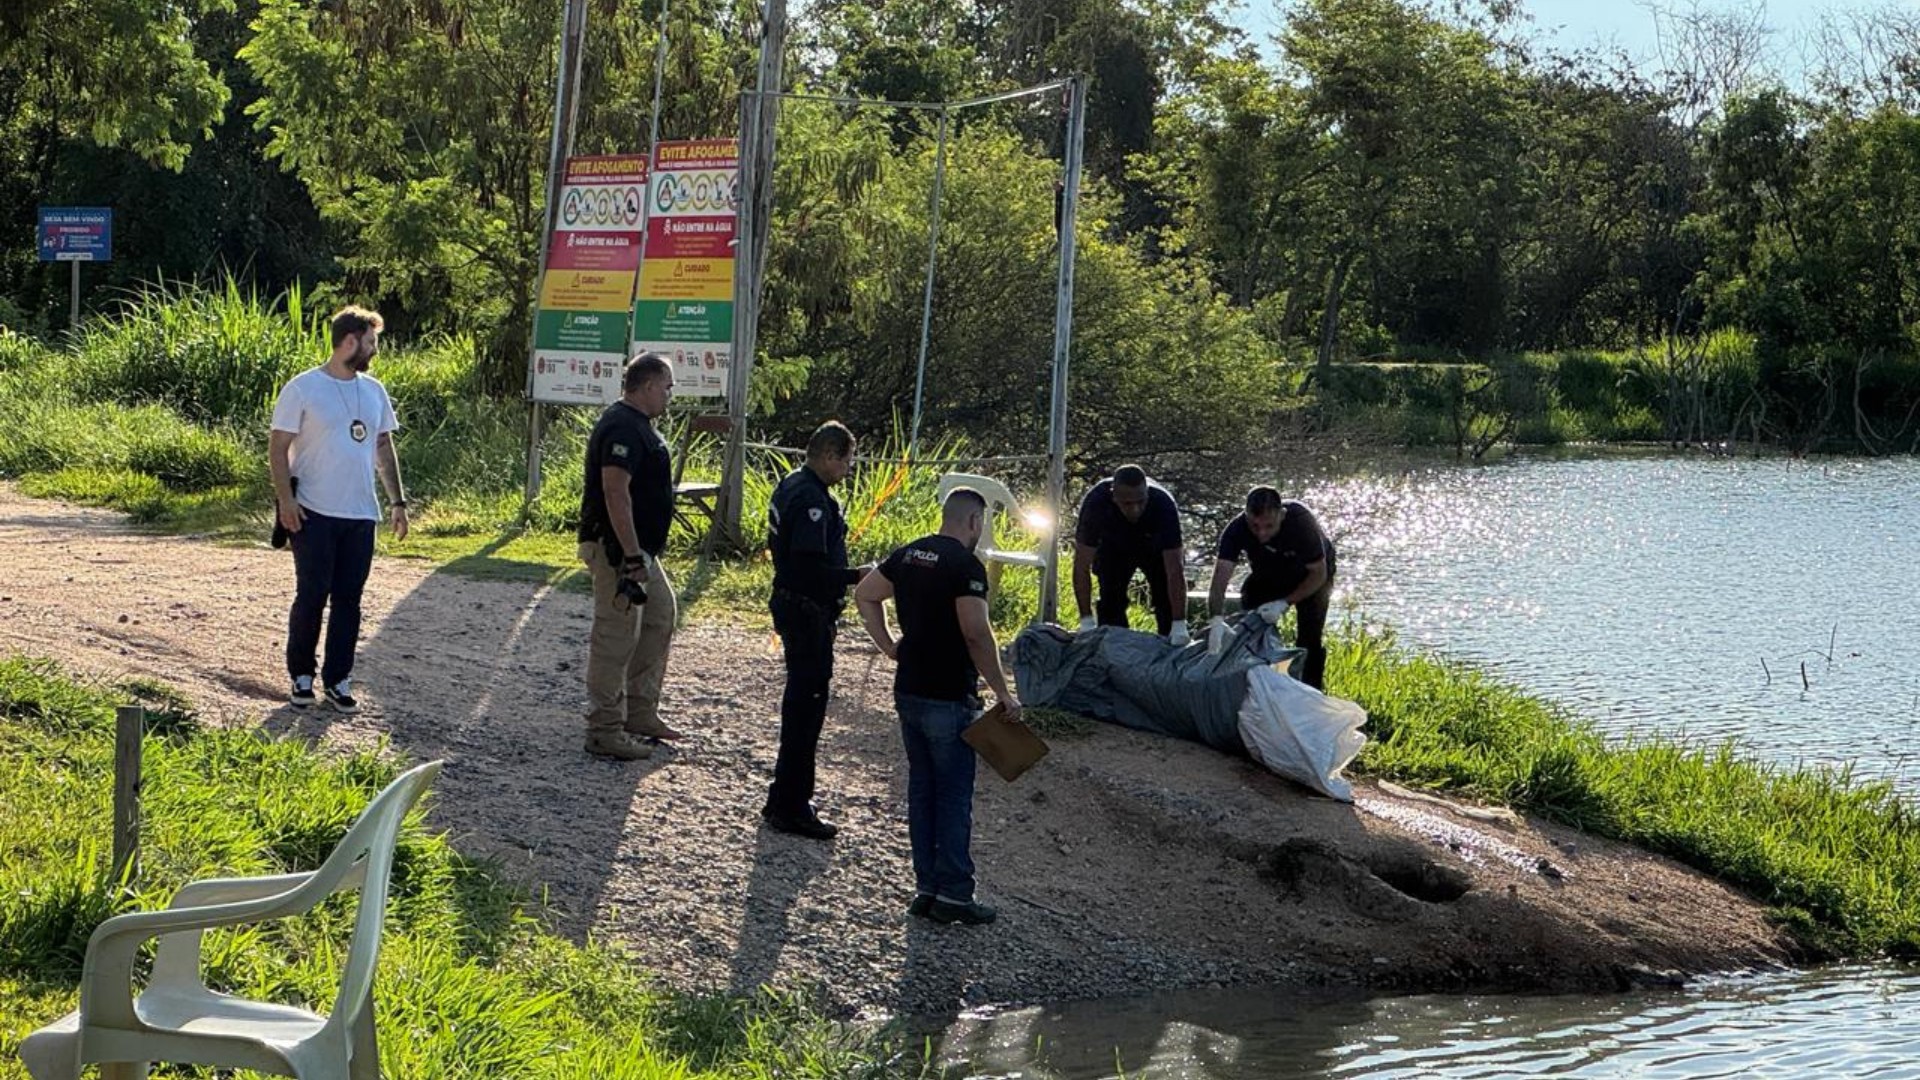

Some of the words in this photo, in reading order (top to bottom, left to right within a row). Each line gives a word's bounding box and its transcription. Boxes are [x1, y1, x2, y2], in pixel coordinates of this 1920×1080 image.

[660, 146, 687, 159] EVITE
[688, 144, 739, 159] AFOGAMEN
[569, 161, 592, 175] EVITE
[592, 160, 645, 174] AFOGAMENTO
[672, 220, 686, 233] NÃO
[686, 222, 704, 233] ENTRE
[705, 222, 714, 232] NA
[715, 220, 732, 232] ÁGUA
[575, 234, 588, 246] NÃO
[588, 237, 605, 246] ENTRE
[605, 237, 615, 246] NA
[684, 264, 711, 273] CUIDADO
[582, 276, 605, 284] CUIDADO
[678, 303, 706, 315] ATENÇÃO
[574, 314, 600, 326] ATENÇÃO
